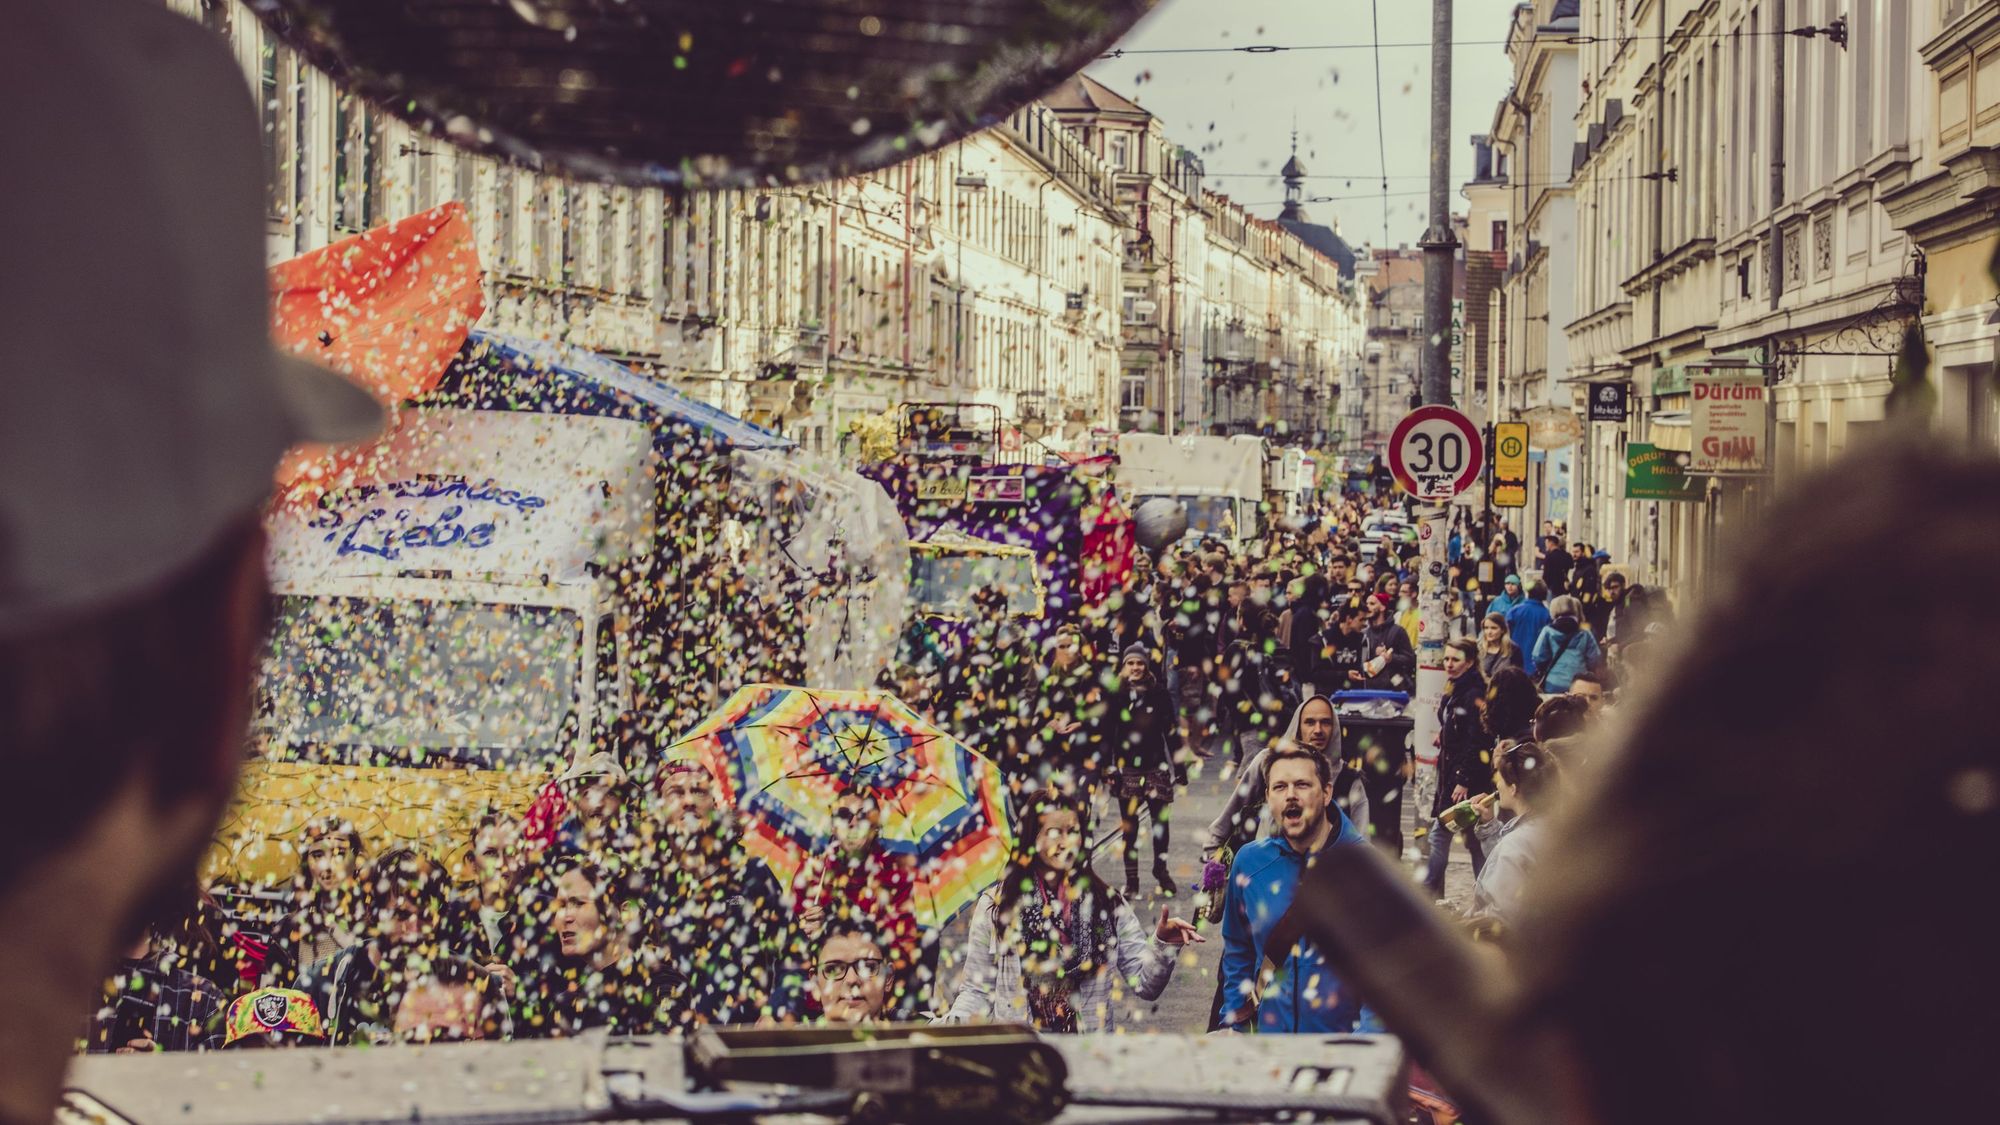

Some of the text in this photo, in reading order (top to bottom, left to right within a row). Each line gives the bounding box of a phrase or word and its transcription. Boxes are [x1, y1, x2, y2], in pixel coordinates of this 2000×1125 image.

[1694, 382, 1762, 401] Dürüm
[1409, 432, 1462, 473] 30
[1507, 441, 1516, 454] H
[1702, 436, 1756, 458] Grill
[337, 504, 497, 560] Liebe
